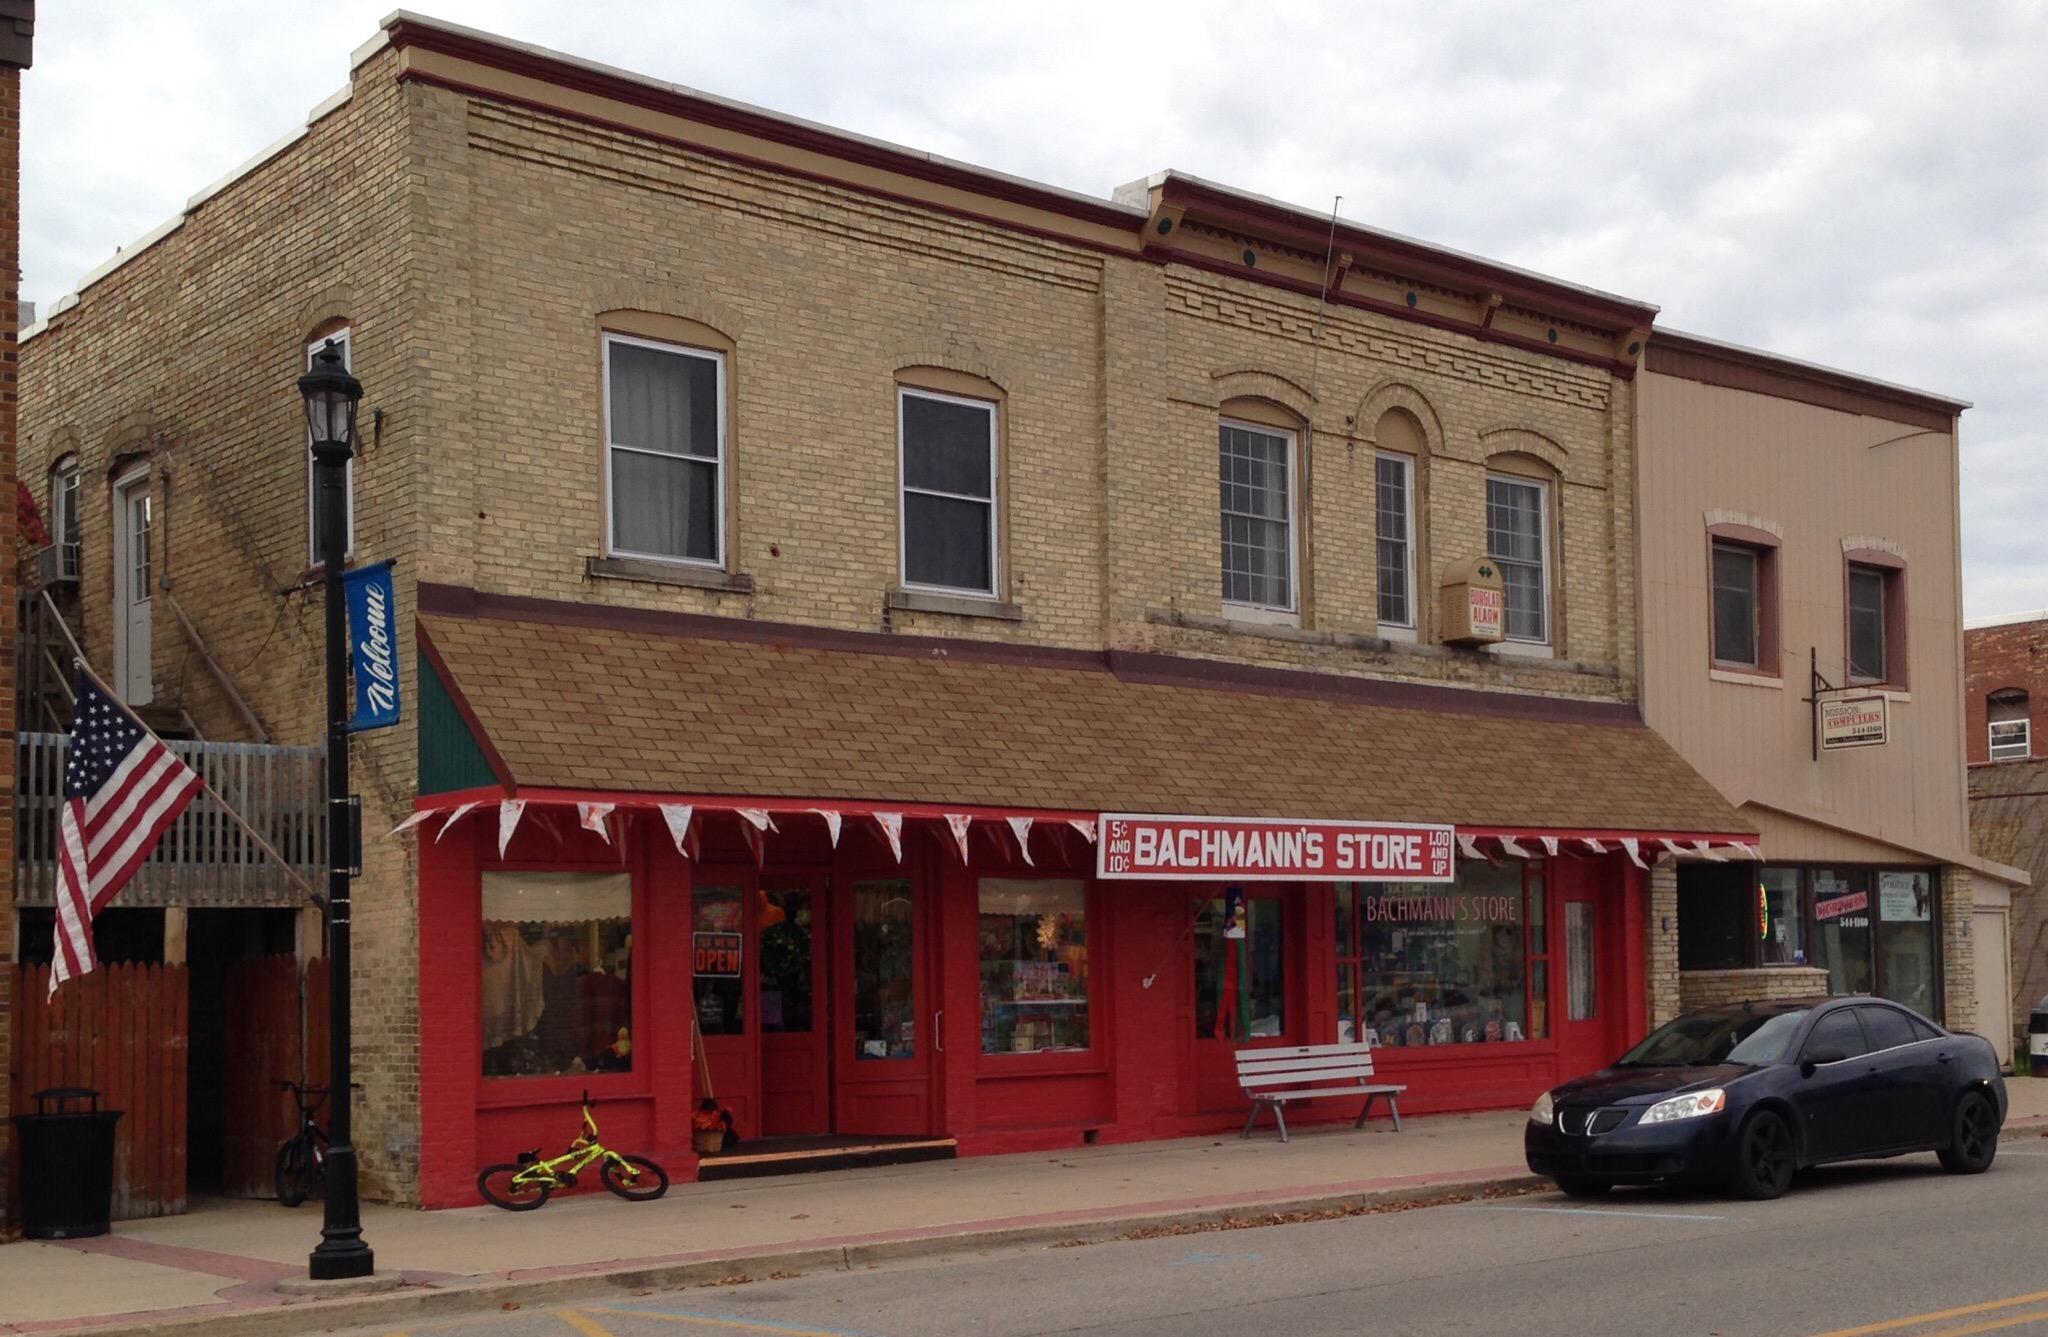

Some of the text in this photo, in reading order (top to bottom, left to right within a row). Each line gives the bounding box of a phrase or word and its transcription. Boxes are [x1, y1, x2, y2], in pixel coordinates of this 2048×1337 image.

[1473, 606, 1499, 624] ALARM
[360, 582, 394, 717] Welcome
[1828, 712, 1880, 728] COMPUTERS
[1112, 821, 1128, 838] 5¢
[1109, 839, 1131, 854] AND
[1429, 831, 1449, 846] 1.00
[1134, 827, 1422, 870] BACHMANN'S STORE
[1431, 847, 1448, 859] AND
[1109, 855, 1130, 872] 10¢
[1433, 860, 1447, 875] UP
[1367, 895, 1516, 921] BACHMANN'S STORE
[695, 948, 739, 972] OPEN
